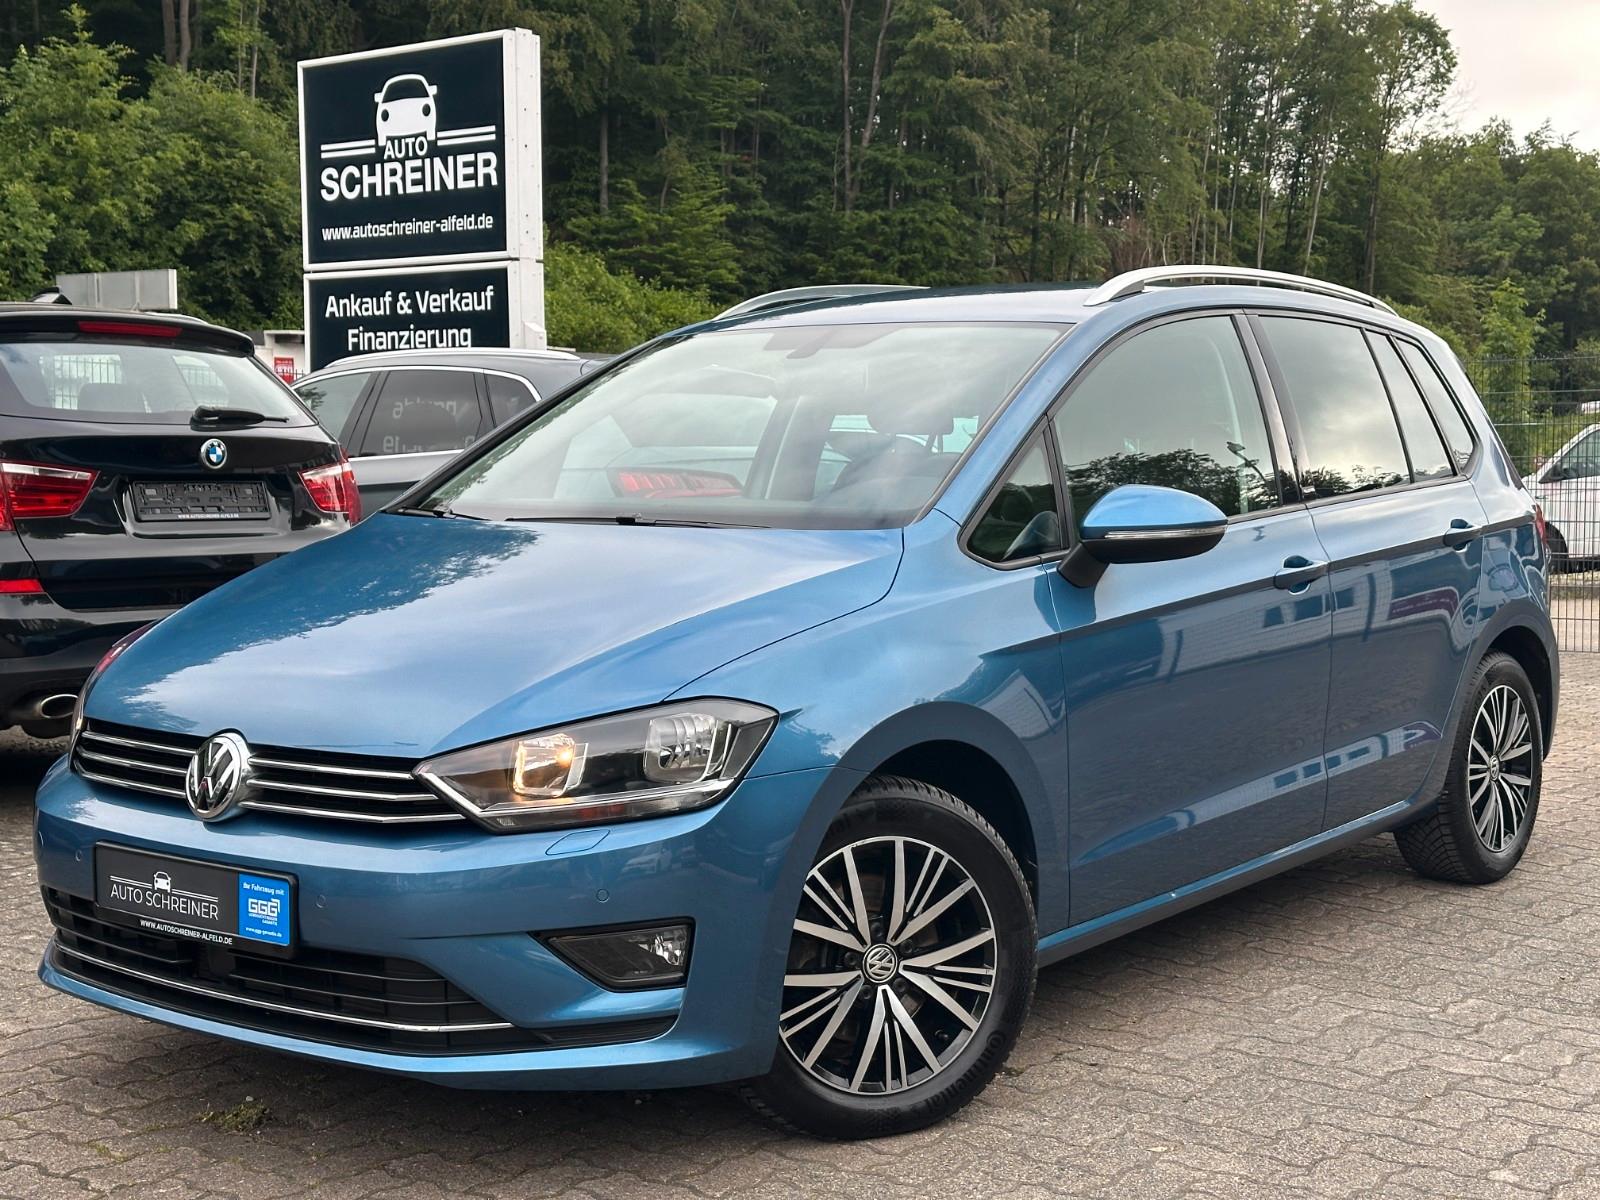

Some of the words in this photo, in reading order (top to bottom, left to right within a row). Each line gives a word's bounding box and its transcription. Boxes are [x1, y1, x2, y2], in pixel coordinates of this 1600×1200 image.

[383, 137, 428, 160] AUTO
[320, 151, 498, 202] SCHREINER
[321, 213, 494, 241] www.autoschreiner-alfeld.de
[325, 291, 393, 318] Ankauf
[396, 292, 413, 315] &
[415, 285, 495, 314] Verkauf
[347, 323, 473, 351] Finanzierung
[110, 883, 144, 904] AUTO
[145, 891, 219, 921] SCHREINER
[248, 898, 280, 917] GGG
[140, 917, 233, 946] WWW.AUTOSCHREINER-ALFELD.DE
